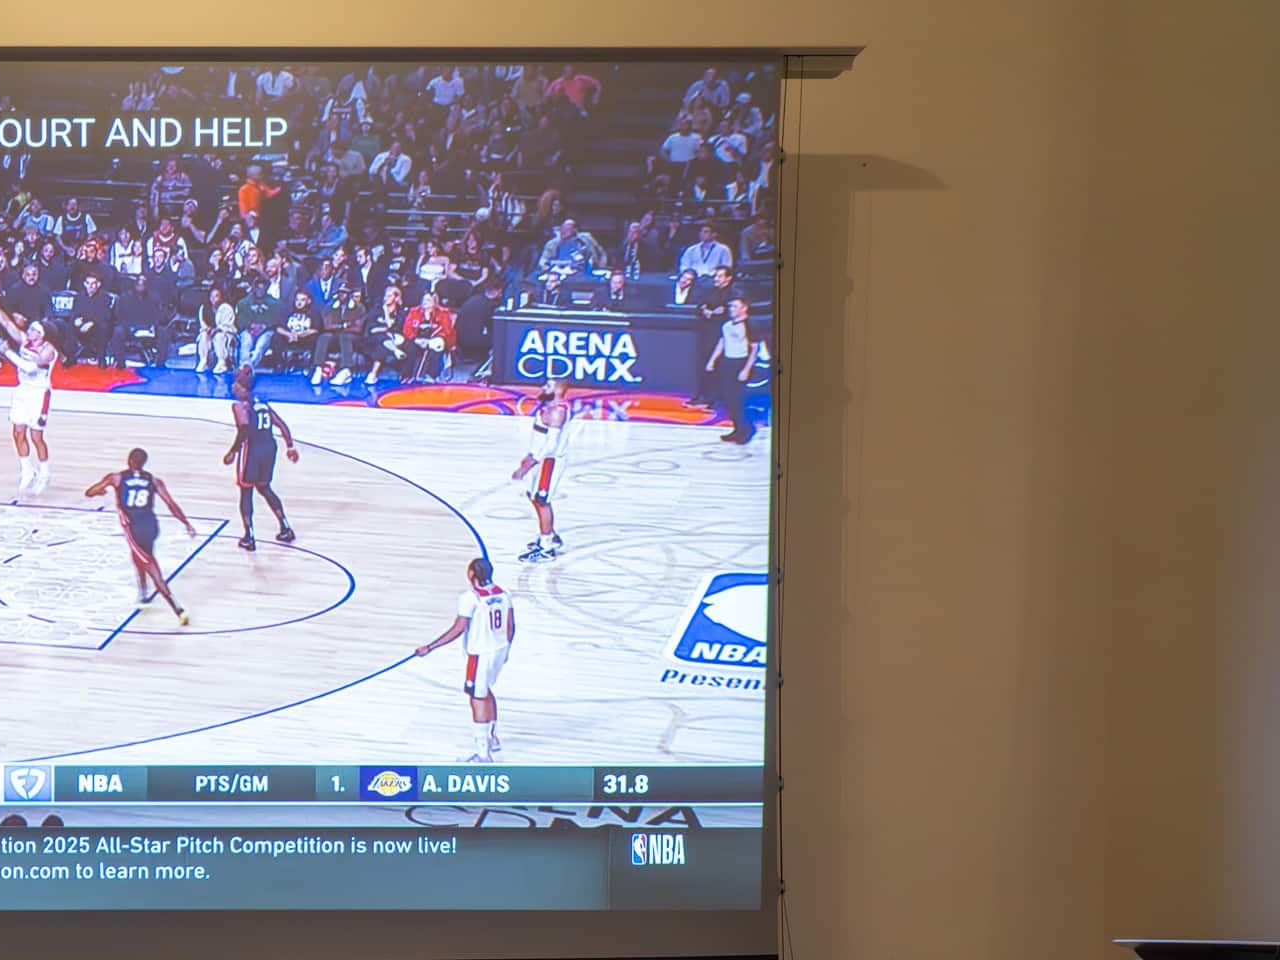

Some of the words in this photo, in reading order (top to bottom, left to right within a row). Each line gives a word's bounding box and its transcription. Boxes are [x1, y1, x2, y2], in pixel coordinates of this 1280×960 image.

[104, 118, 183, 148] AND
[194, 118, 288, 147] HELP
[520, 330, 637, 357] ARENA
[126, 489, 150, 507] 18
[690, 642, 767, 665] NBA
[78, 773, 123, 793] NBA
[195, 774, 269, 793] PTS/GM
[331, 775, 345, 793] 1.
[422, 775, 443, 793] A.
[448, 774, 510, 793] DAVIS
[603, 774, 649, 794] 31.8
[43, 837, 90, 854] 2025
[95, 836, 170, 854] All-Star
[176, 836, 224, 854] Pitch
[230, 836, 345, 858] Competition
[350, 837, 367, 853] is
[373, 841, 412, 853] now
[417, 836, 457, 853] live!
[649, 834, 685, 865] NBA
[75, 865, 94, 879] to
[99, 863, 148, 879] learn
[155, 866, 210, 880] more.
